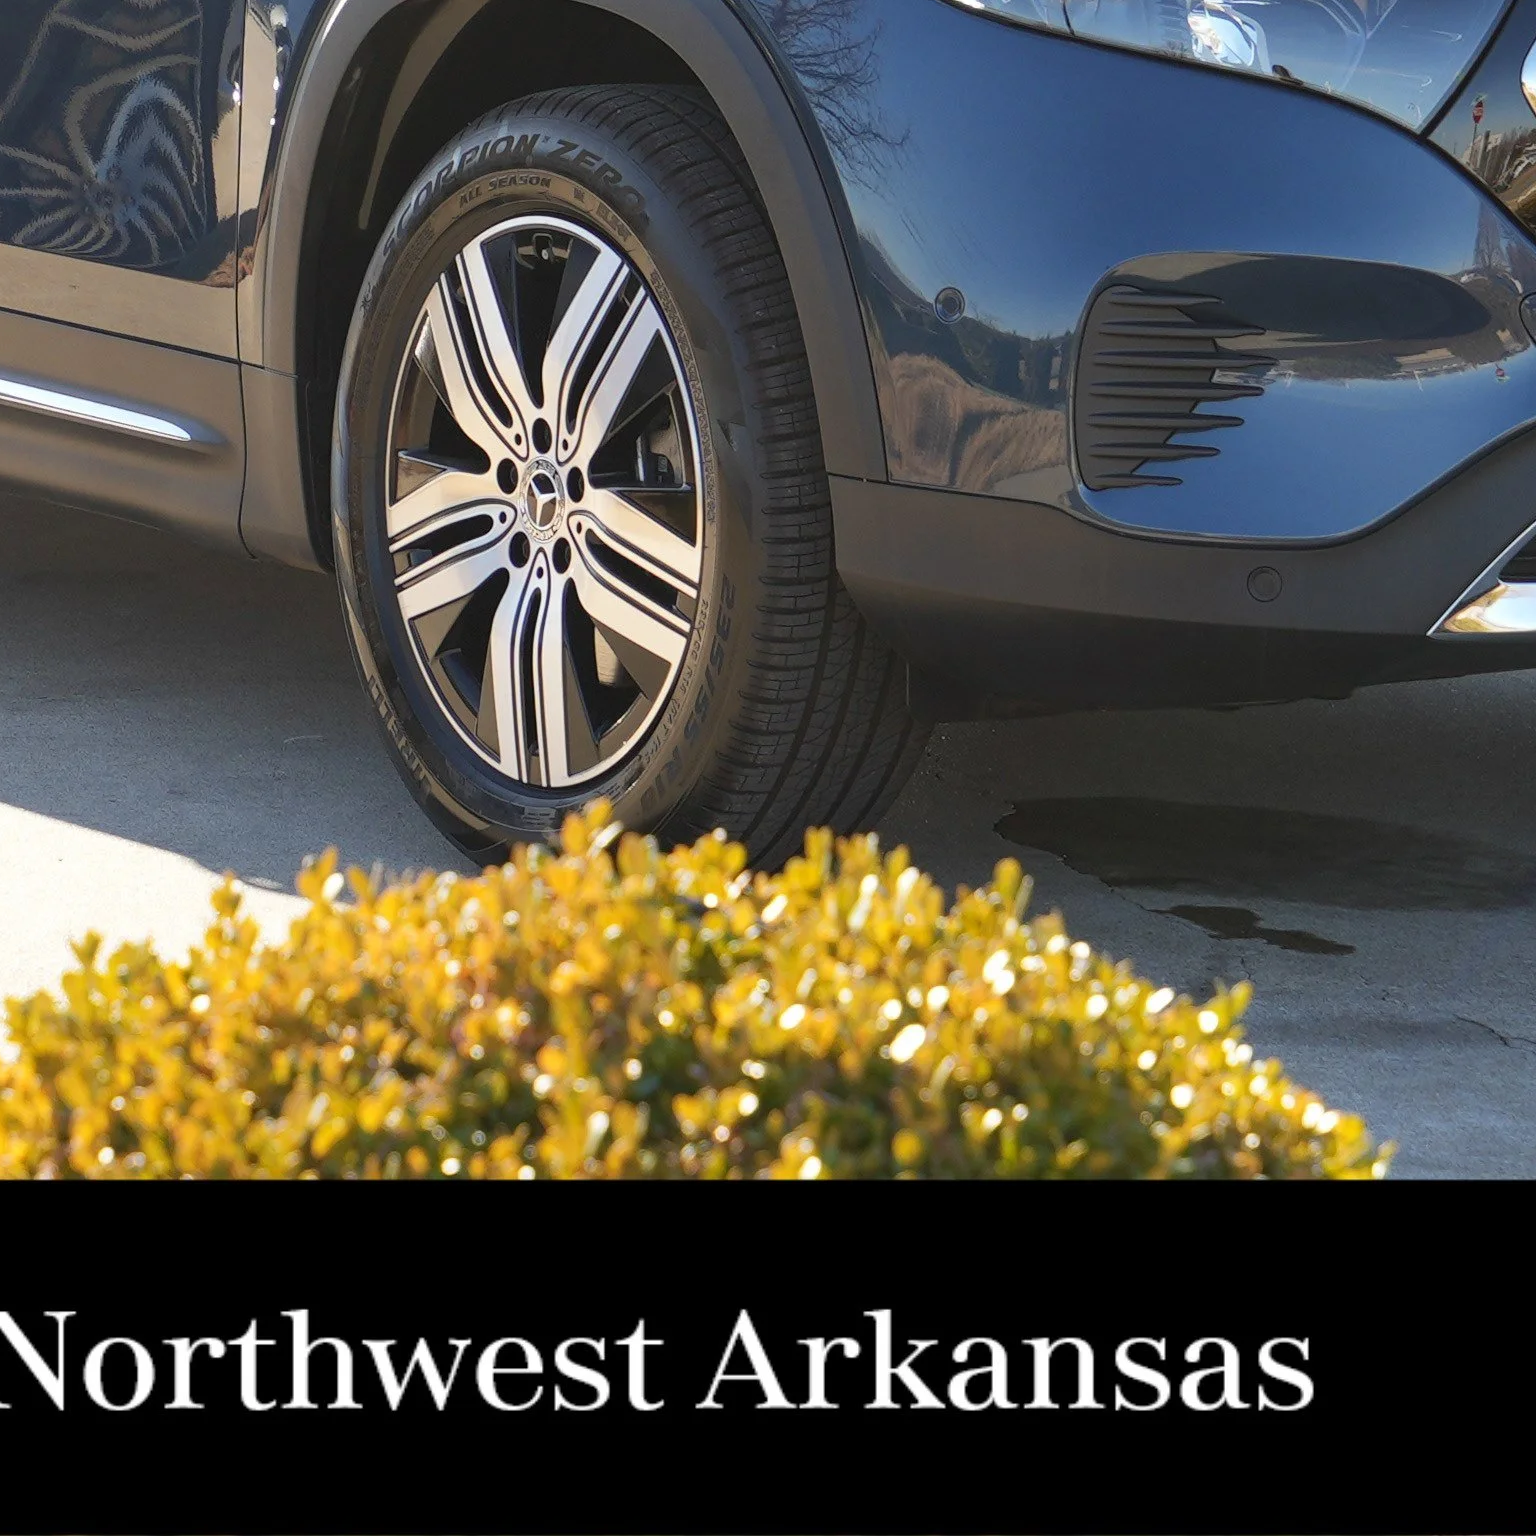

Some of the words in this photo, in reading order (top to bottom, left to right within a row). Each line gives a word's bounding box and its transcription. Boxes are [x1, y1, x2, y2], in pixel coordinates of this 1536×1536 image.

[459, 189, 482, 210] ALL
[488, 175, 552, 192] SEASON
[546, 139, 648, 216] ZERO
